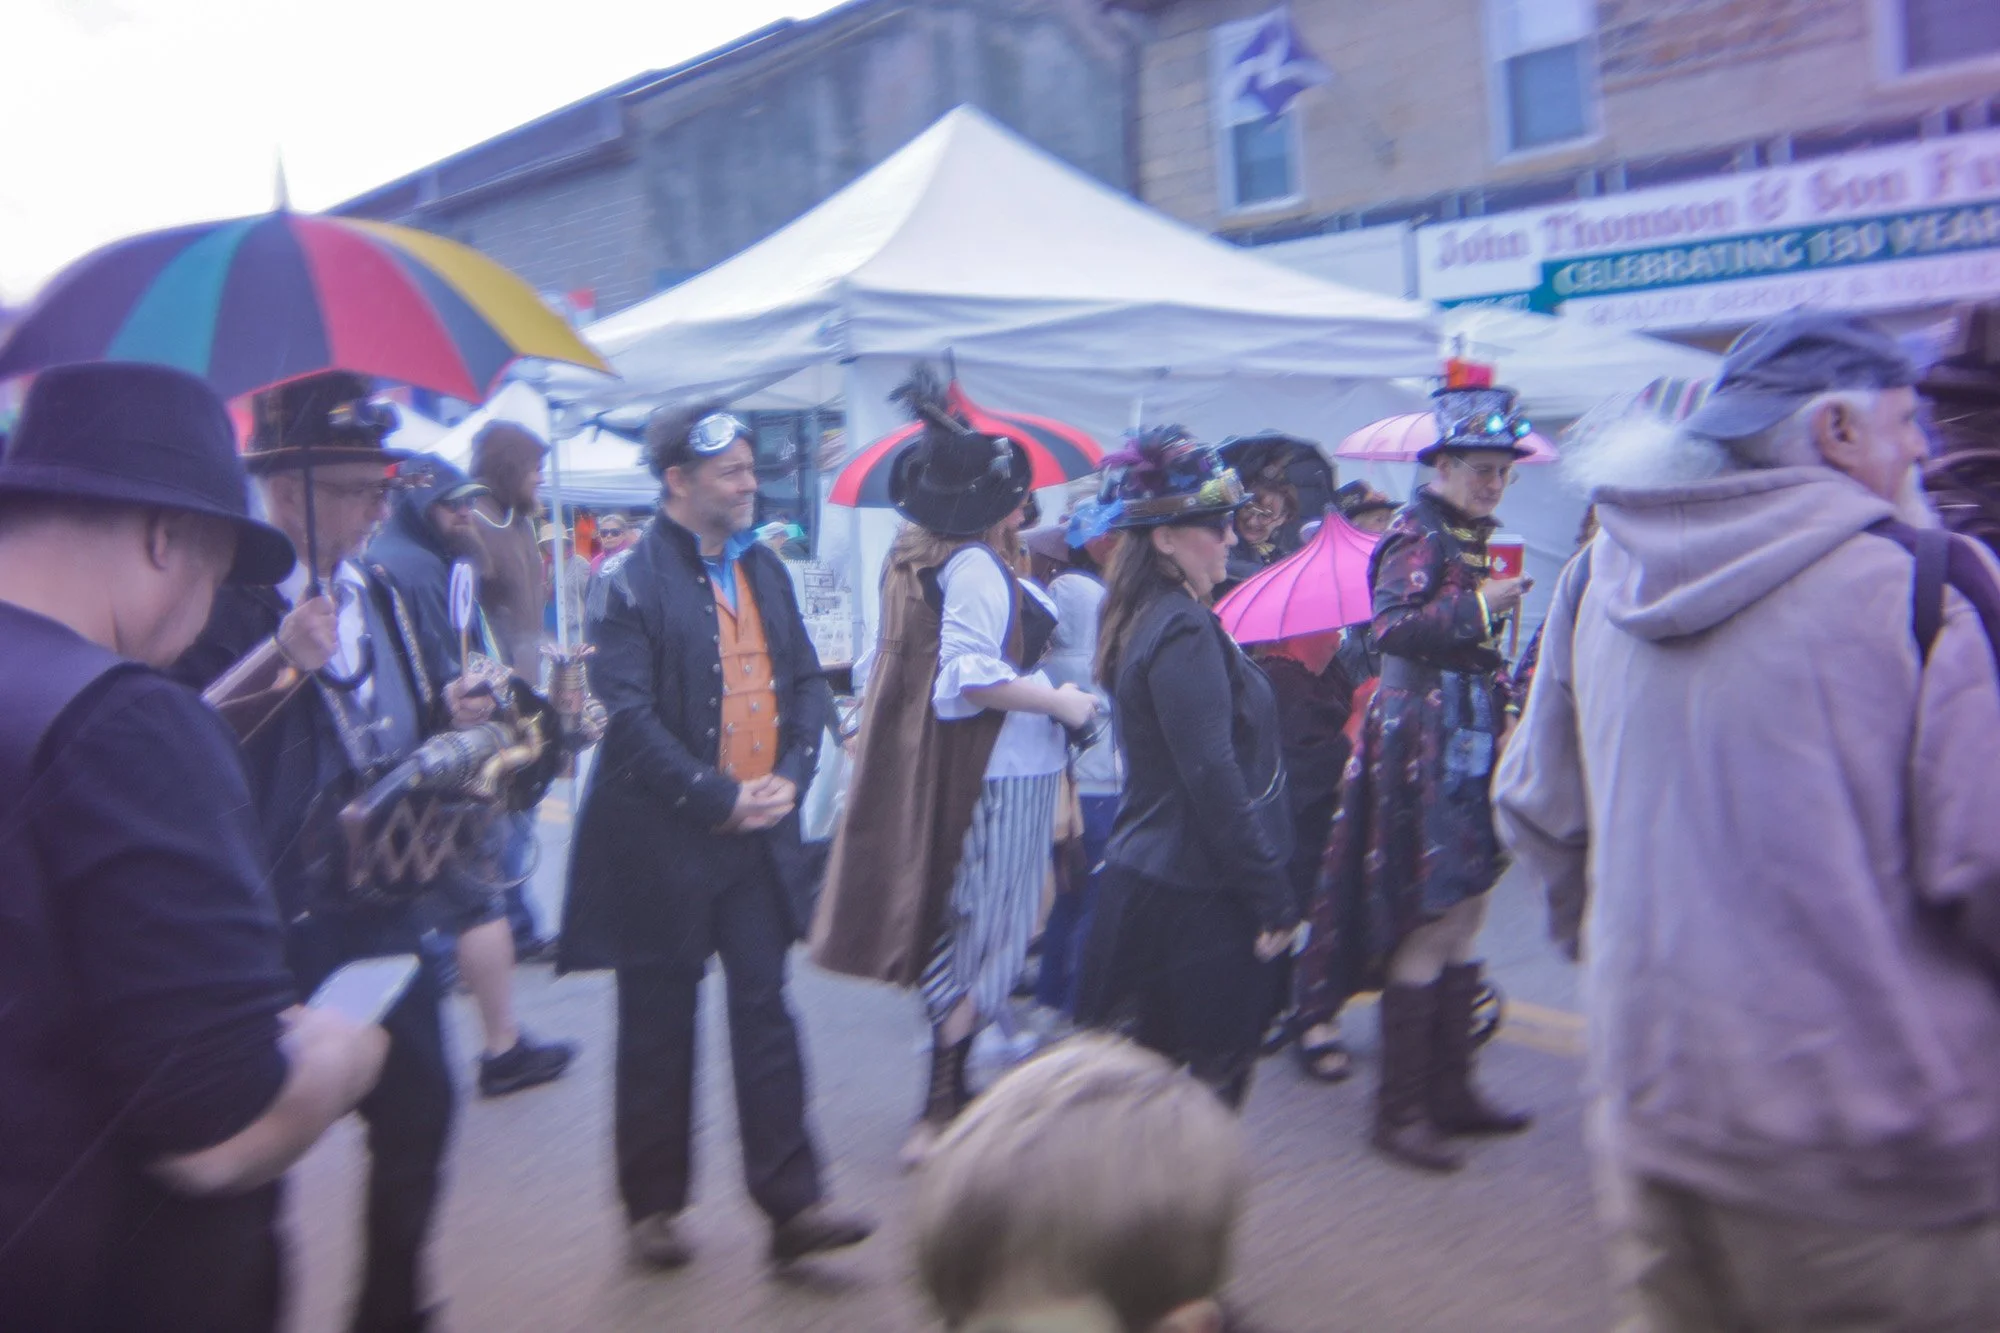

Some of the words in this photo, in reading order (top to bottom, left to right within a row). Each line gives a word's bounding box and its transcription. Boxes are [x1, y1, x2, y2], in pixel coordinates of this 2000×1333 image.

[1437, 224, 1532, 270] John
[1541, 198, 1737, 251] Thomson
[1748, 173, 1792, 222] &
[1808, 165, 1910, 213] Son
[1552, 231, 1804, 296] CELEBRATING
[1804, 222, 1886, 266] 130
